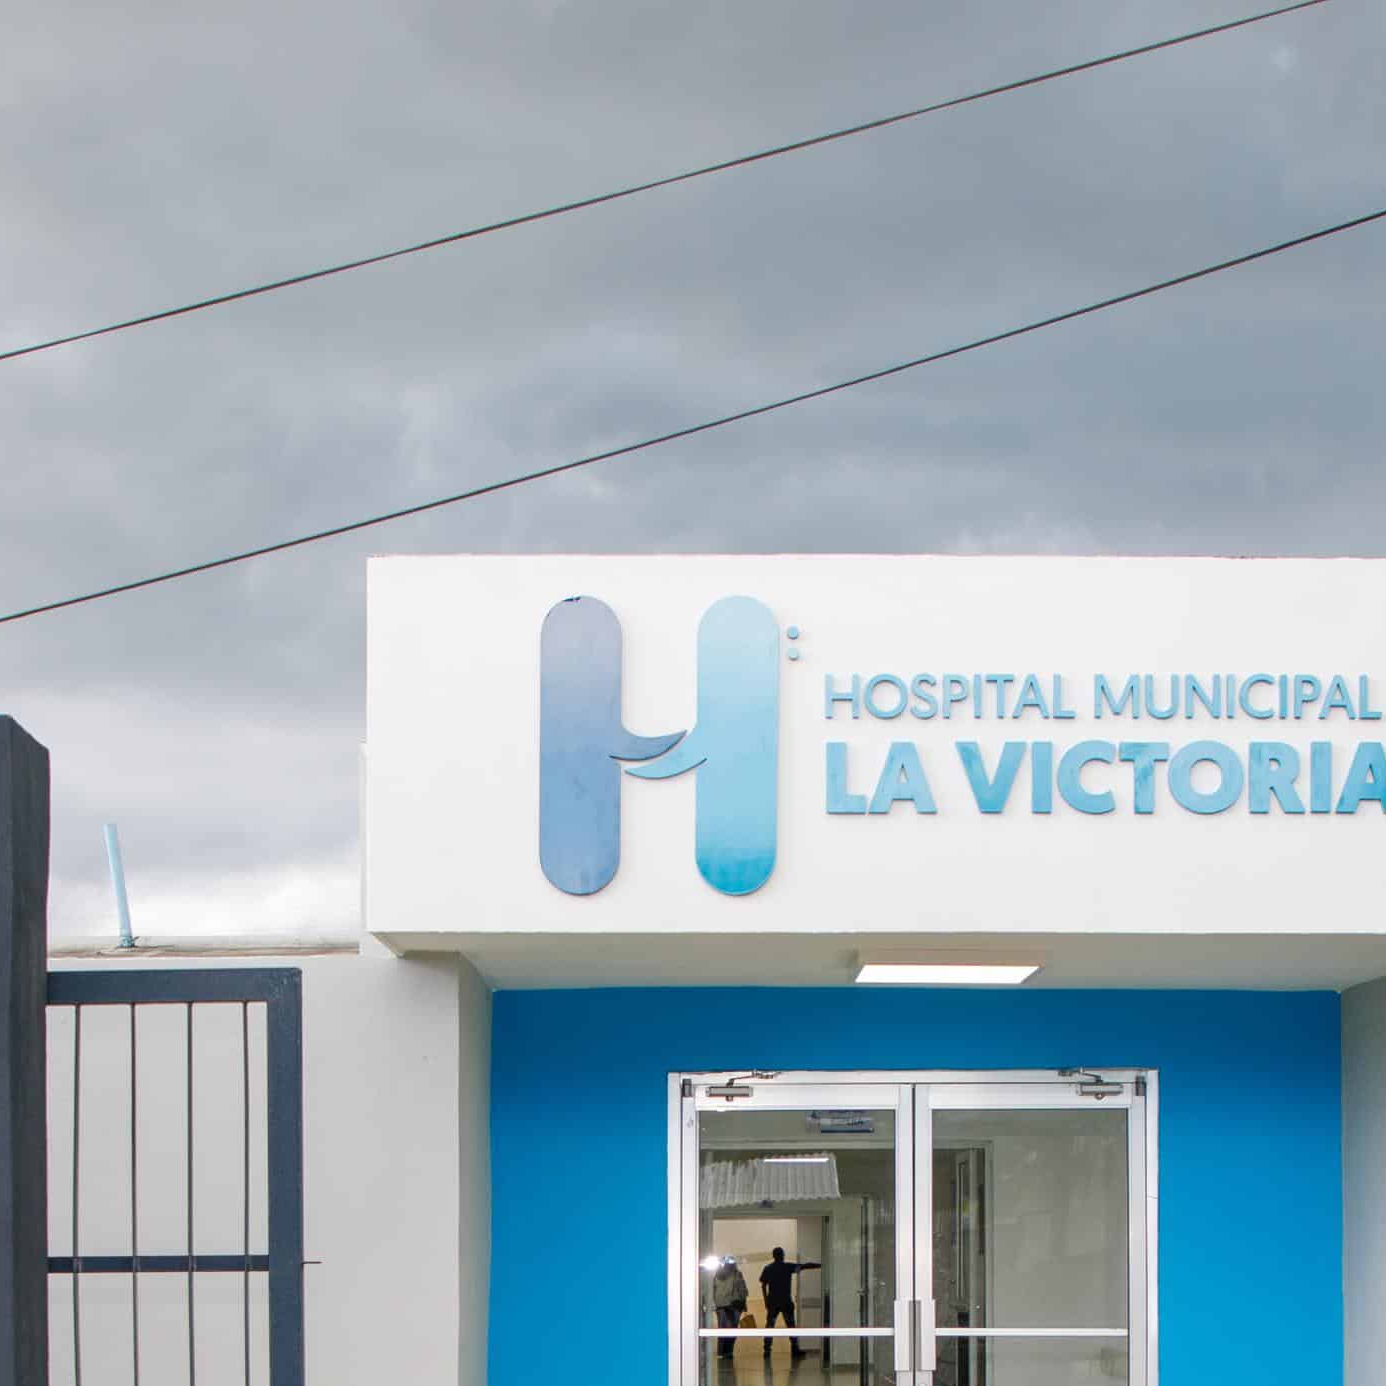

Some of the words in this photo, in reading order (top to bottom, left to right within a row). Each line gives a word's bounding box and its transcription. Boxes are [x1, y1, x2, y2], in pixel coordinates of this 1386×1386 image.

[824, 673, 1077, 719] HOSPITAL
[1093, 673, 1382, 720] MUNICIPAL
[825, 741, 938, 815] LA
